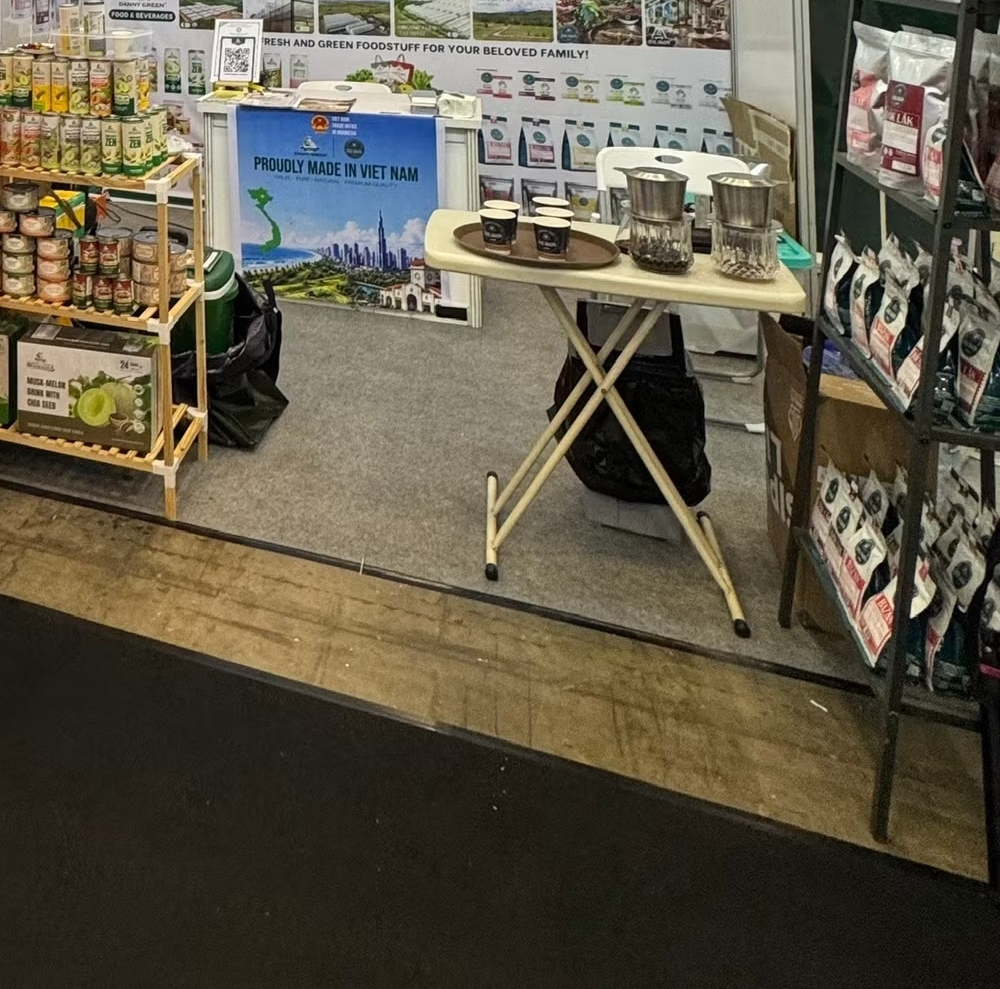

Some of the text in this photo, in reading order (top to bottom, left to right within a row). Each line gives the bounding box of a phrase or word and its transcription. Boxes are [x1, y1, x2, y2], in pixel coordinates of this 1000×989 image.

[111, 11, 129, 19] FOOD
[135, 12, 173, 20] BEVERAGES
[293, 38, 315, 48] AND
[318, 40, 353, 49] GREEN
[356, 41, 420, 52] FOODSTUFF
[423, 44, 445, 53] FOR
[449, 45, 480, 55] YOUR
[483, 46, 537, 57] BELOVED
[540, 48, 589, 59] FAMILY!
[105, 137, 117, 147] ZEN
[129, 139, 141, 149] ZEN
[254, 156, 419, 182] PROUDLY MADE IN VIET NAM
[120, 360, 129, 370] 24
[27, 387, 60, 399] DRINK WITH
[27, 398, 56, 410] CHIA SEED
